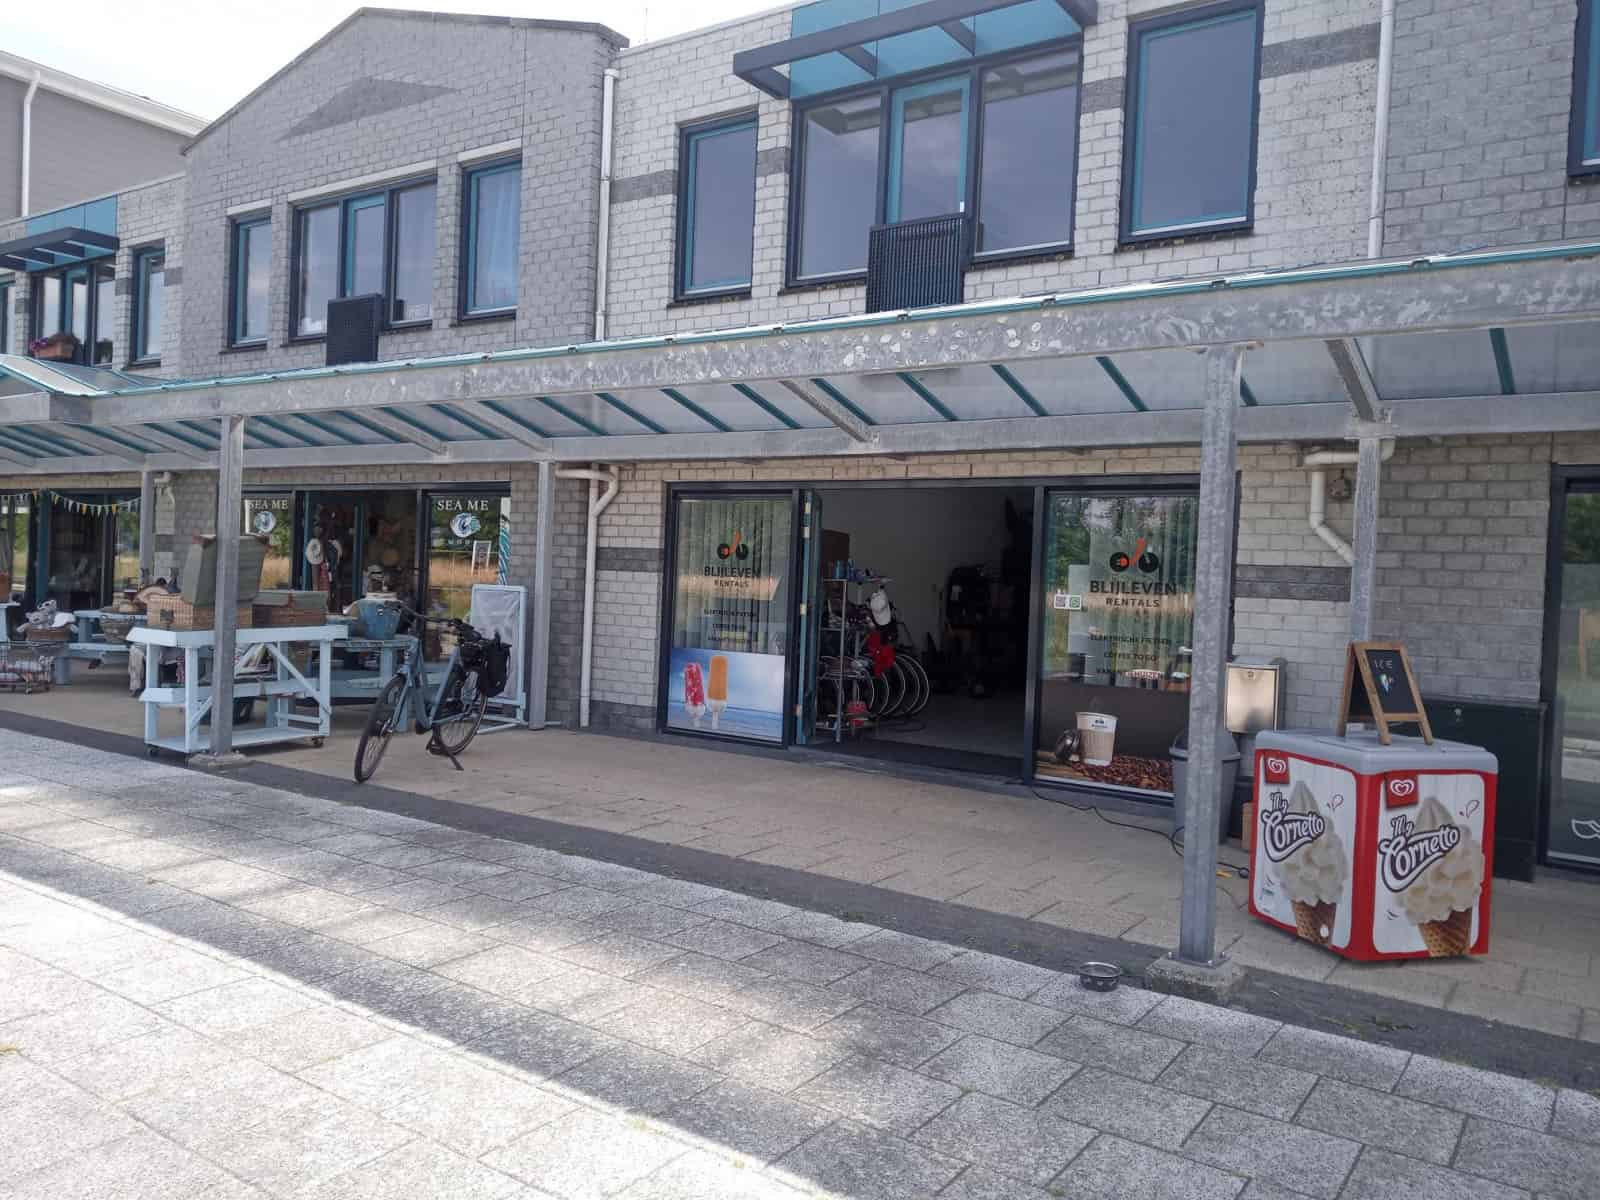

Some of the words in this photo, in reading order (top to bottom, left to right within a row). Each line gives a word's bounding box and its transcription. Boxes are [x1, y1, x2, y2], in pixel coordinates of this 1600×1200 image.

[271, 499, 289, 510] ME
[436, 499, 463, 511] SEA
[467, 499, 489, 511] ME
[704, 566, 762, 577] BLIJLEVEN
[714, 579, 749, 588] RENTALS
[1089, 580, 1177, 595] BLIJLEVEN
[1105, 597, 1161, 608] RENTALS
[1374, 656, 1393, 669] ICE
[1261, 810, 1325, 863] Cornetto
[1378, 824, 1461, 892] Cornetto
